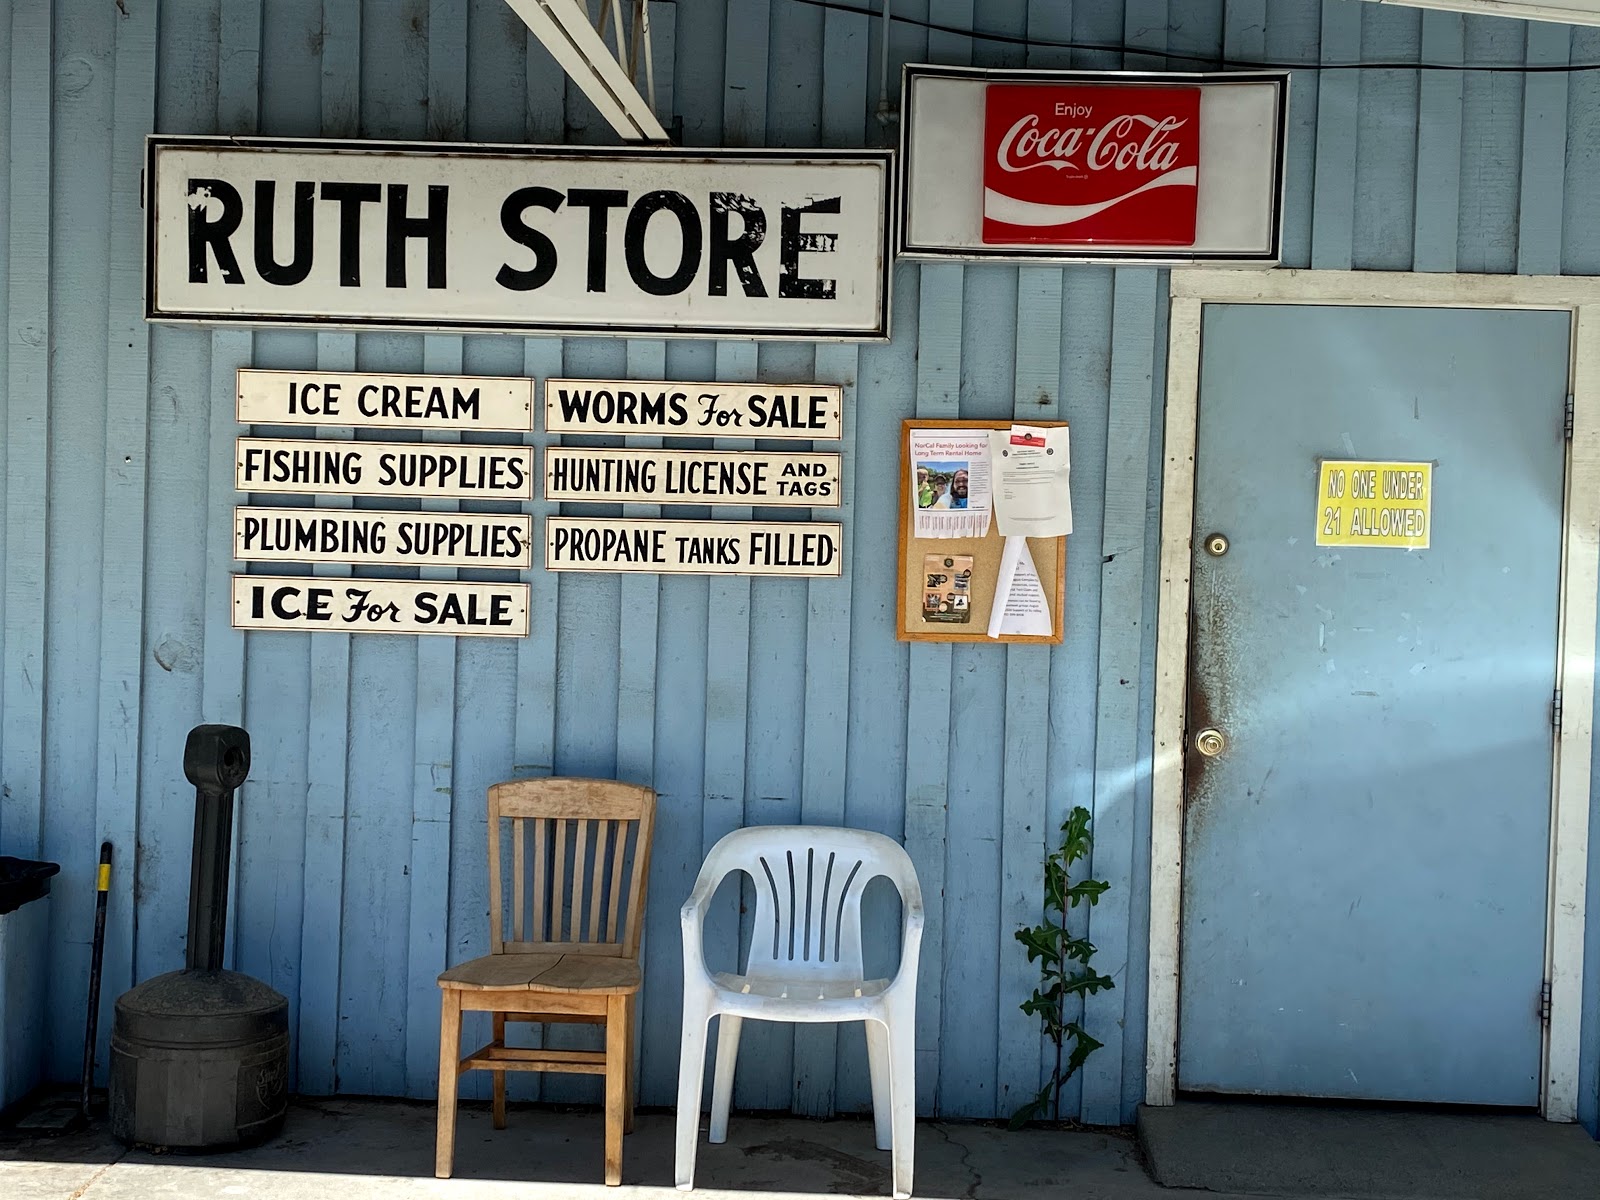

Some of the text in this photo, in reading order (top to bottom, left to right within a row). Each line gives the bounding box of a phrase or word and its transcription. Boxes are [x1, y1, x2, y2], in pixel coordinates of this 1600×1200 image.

[1055, 102, 1093, 119] Enjoy
[997, 114, 1188, 172] Coca-Cola
[188, 178, 841, 300] RUTH STORE
[288, 382, 480, 420] ICE CREAM
[558, 390, 828, 429] WORMS For SALE
[935, 442, 955, 450] Family
[955, 442, 979, 450] Looking
[244, 449, 524, 490] FISHING SUPPLIES
[553, 458, 769, 495] HUNTING LICENSE
[776, 481, 831, 496] TAGS
[781, 463, 827, 477] AND
[1327, 469, 1424, 500] NO ONE UNDER
[244, 517, 522, 558] PLUMBING SUPPLIES
[1323, 506, 1425, 537] 21 ALLOWED
[554, 527, 834, 566] PROPANE TANKS FILLED
[251, 586, 514, 626] ICE For SALE
